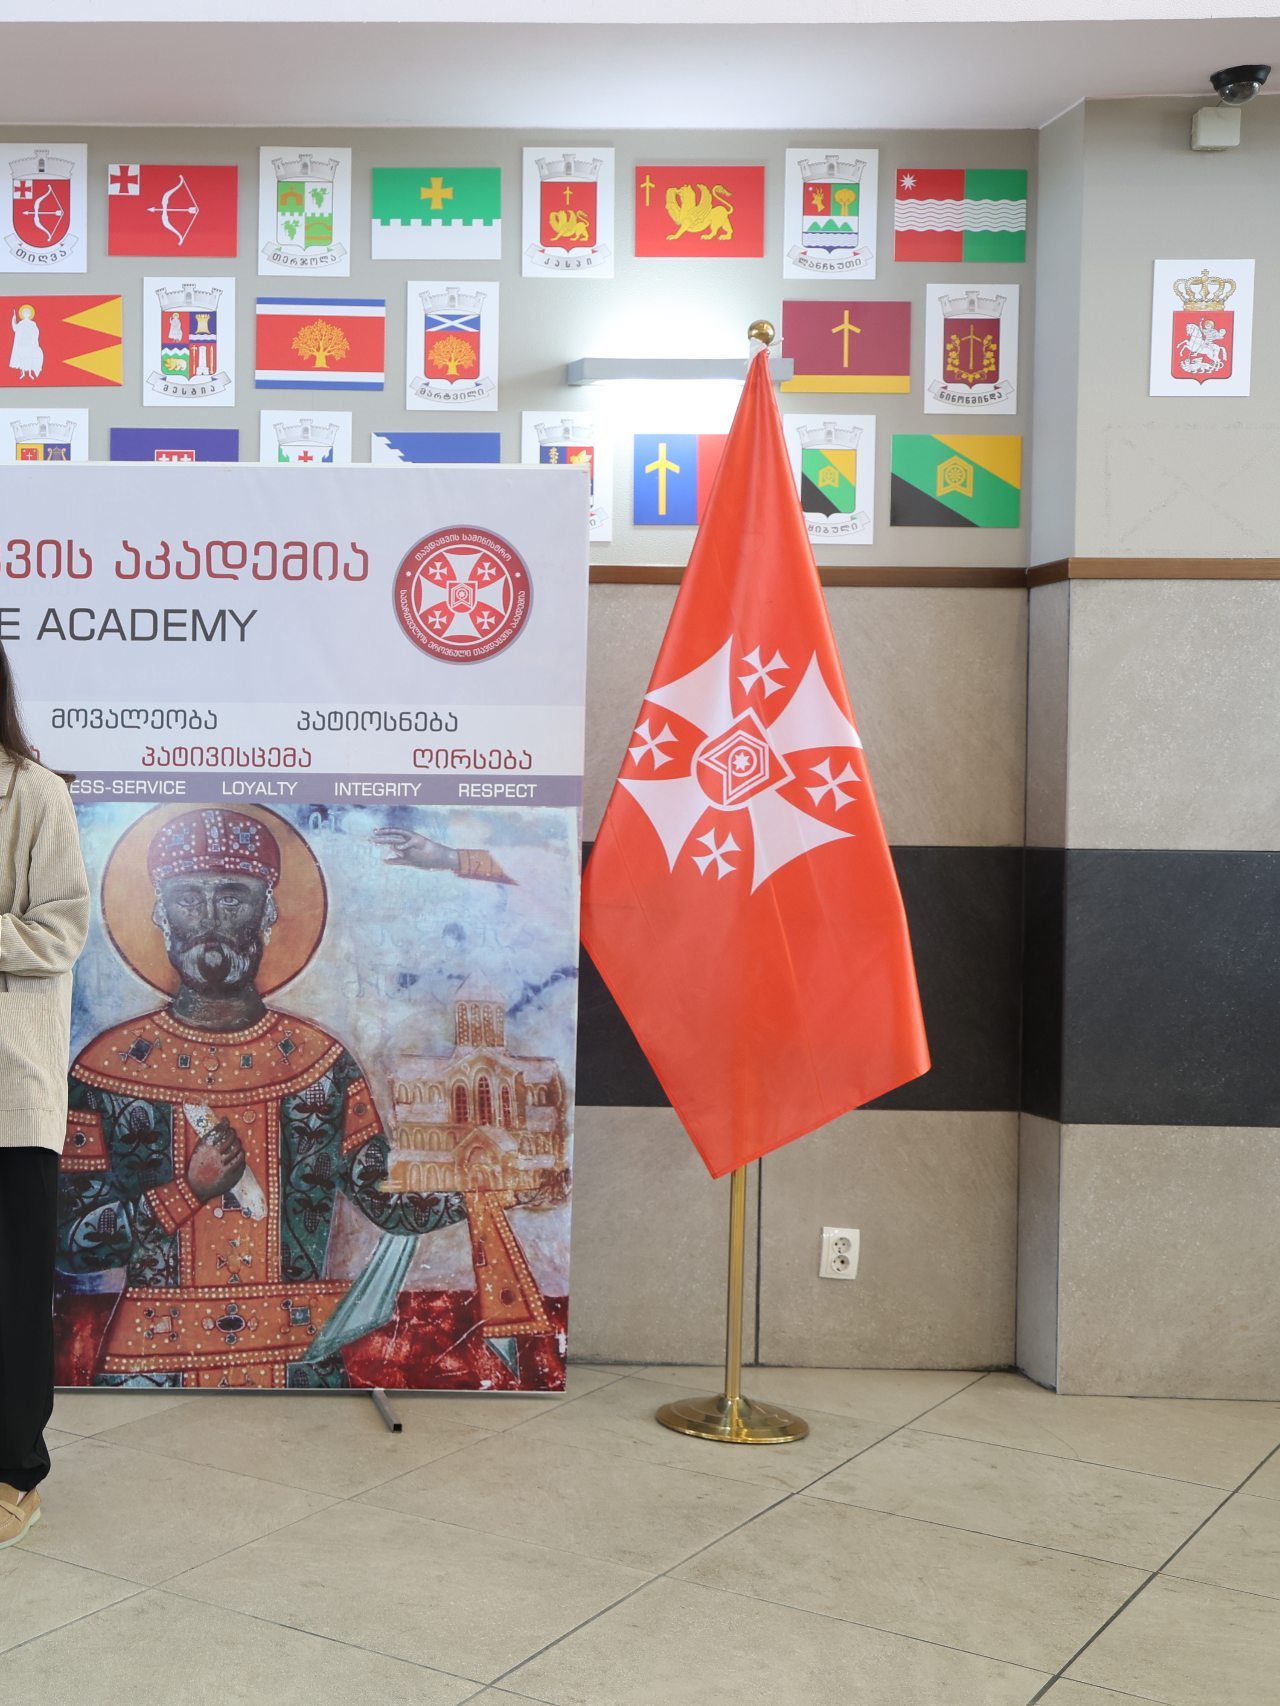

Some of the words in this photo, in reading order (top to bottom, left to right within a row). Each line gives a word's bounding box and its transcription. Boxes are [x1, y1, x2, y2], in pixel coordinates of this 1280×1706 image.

[15, 248, 67, 263] თიღვა
[272, 254, 337, 266] თერჯოლა
[544, 257, 593, 268] კასპი
[799, 257, 862, 270] ლანჩხუთი
[808, 522, 858, 534] ყიბული
[115, 540, 369, 582] აკადემია
[36, 608, 258, 642] ACADEMY
[52, 708, 217, 729] მოვალეობა
[297, 710, 458, 732] პატიოსნება
[142, 746, 312, 768] პატივისცემა
[413, 748, 532, 769] ღირსება
[70, 780, 186, 795] ESS-SERVICE
[222, 781, 298, 795] LOYALTY
[334, 782, 422, 797] INTEGRITY
[459, 784, 538, 798] RESPECT
